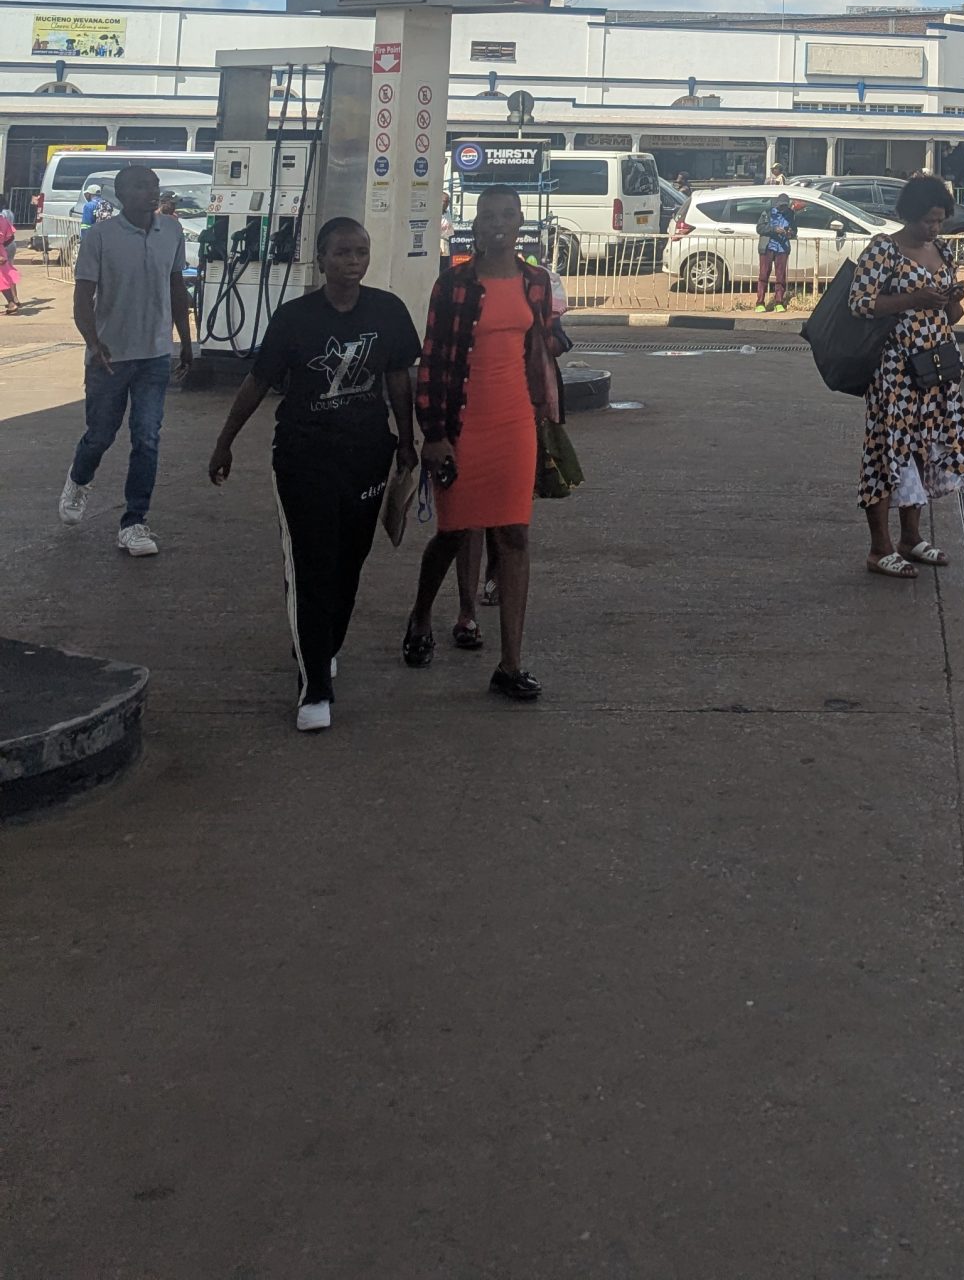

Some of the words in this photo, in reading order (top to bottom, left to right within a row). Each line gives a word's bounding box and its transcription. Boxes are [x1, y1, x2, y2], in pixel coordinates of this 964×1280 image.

[375, 46, 386, 54] Fire
[387, 46, 401, 54] Point
[485, 149, 538, 158] THIRSTY
